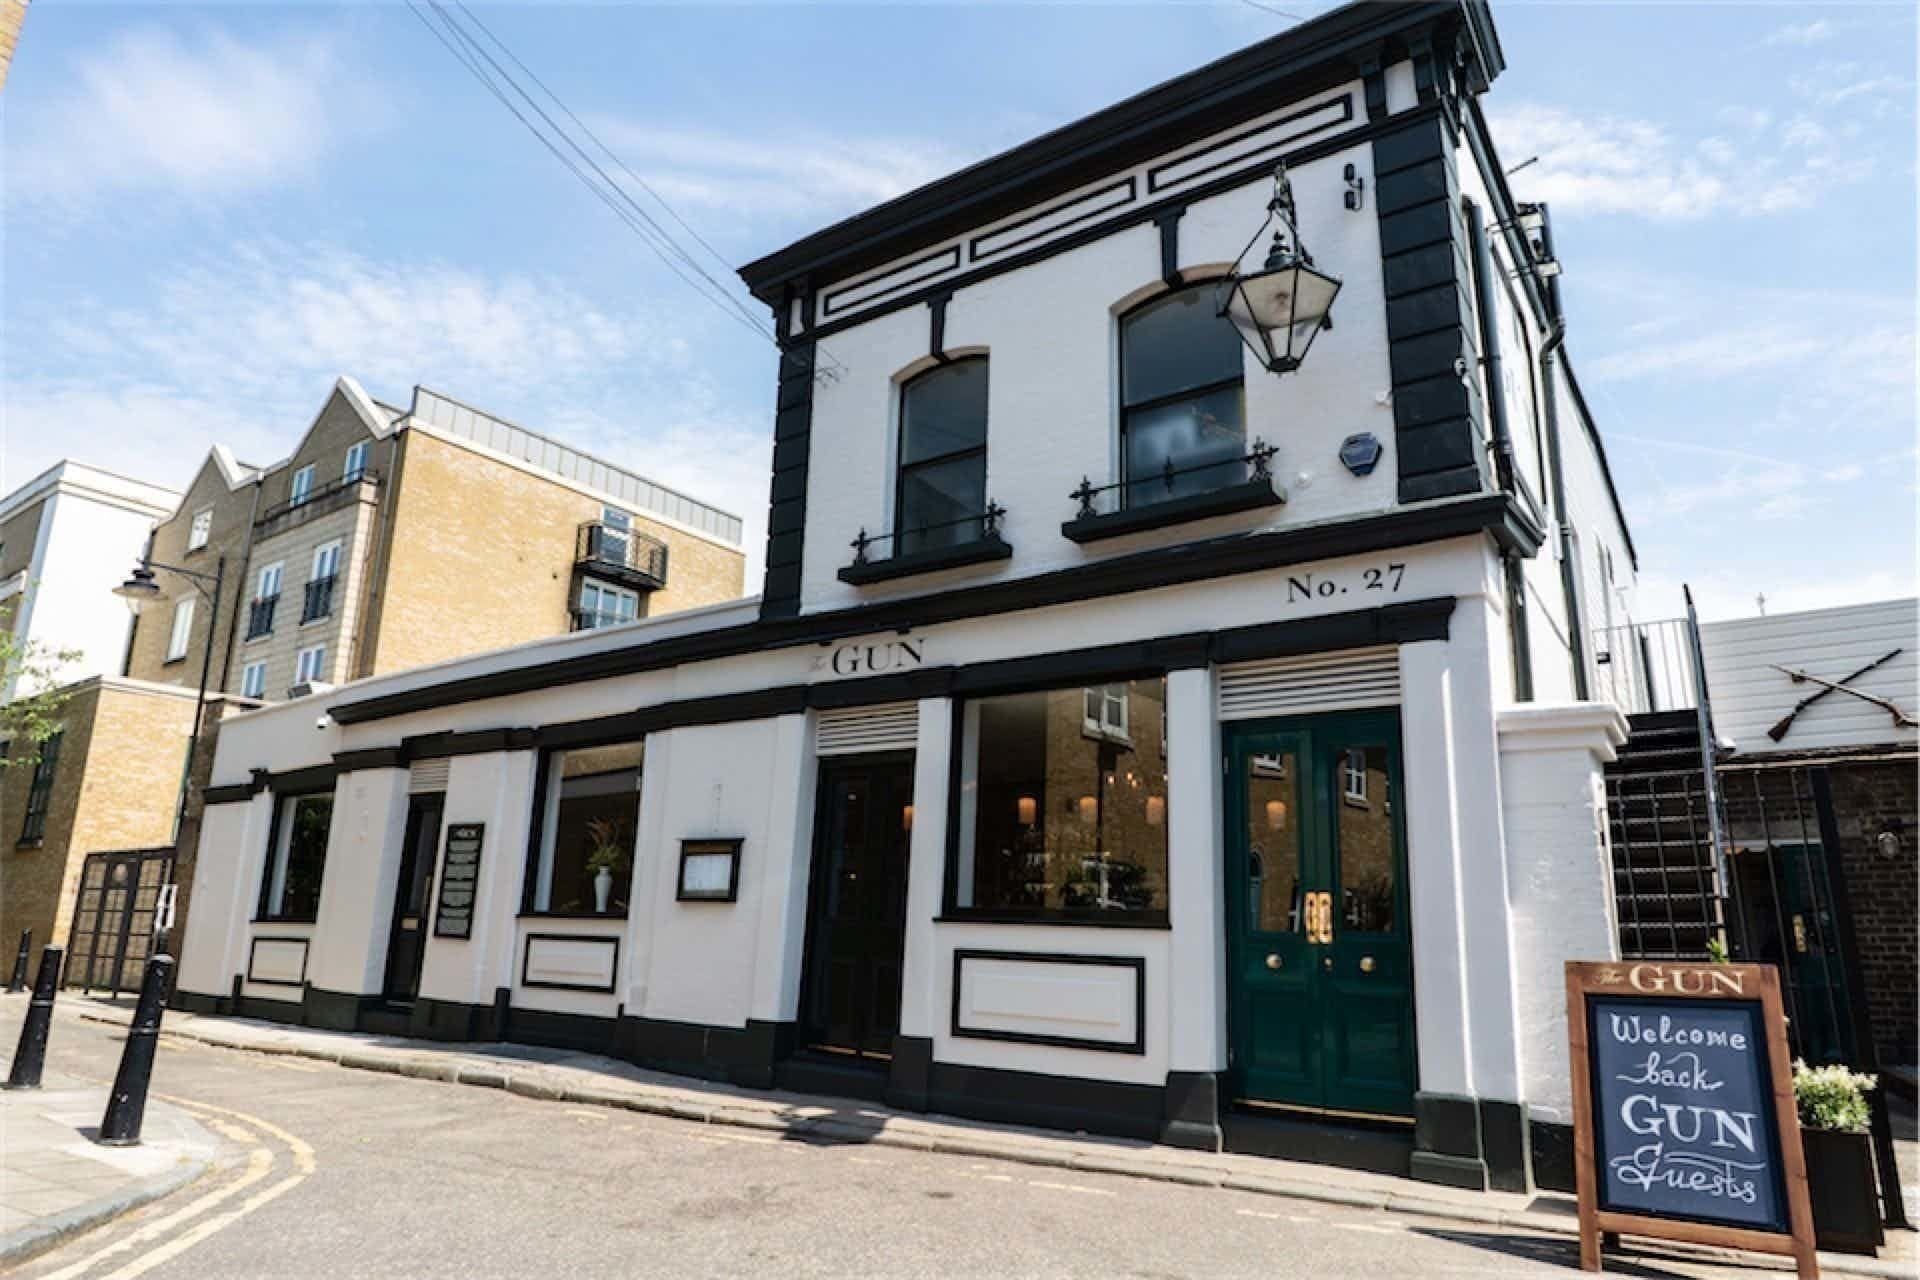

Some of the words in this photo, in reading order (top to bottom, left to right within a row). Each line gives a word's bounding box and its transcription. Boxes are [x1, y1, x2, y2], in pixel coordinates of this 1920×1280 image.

[1287, 573, 1347, 604] No.
[1363, 563, 1406, 592] 27
[833, 639, 926, 676] GUN
[1629, 965, 1745, 995] GUN
[1609, 1013, 1747, 1050] Welcome
[1616, 1051, 1724, 1091] back
[1620, 1094, 1760, 1153] GUN
[1610, 1143, 1761, 1204] Guests
